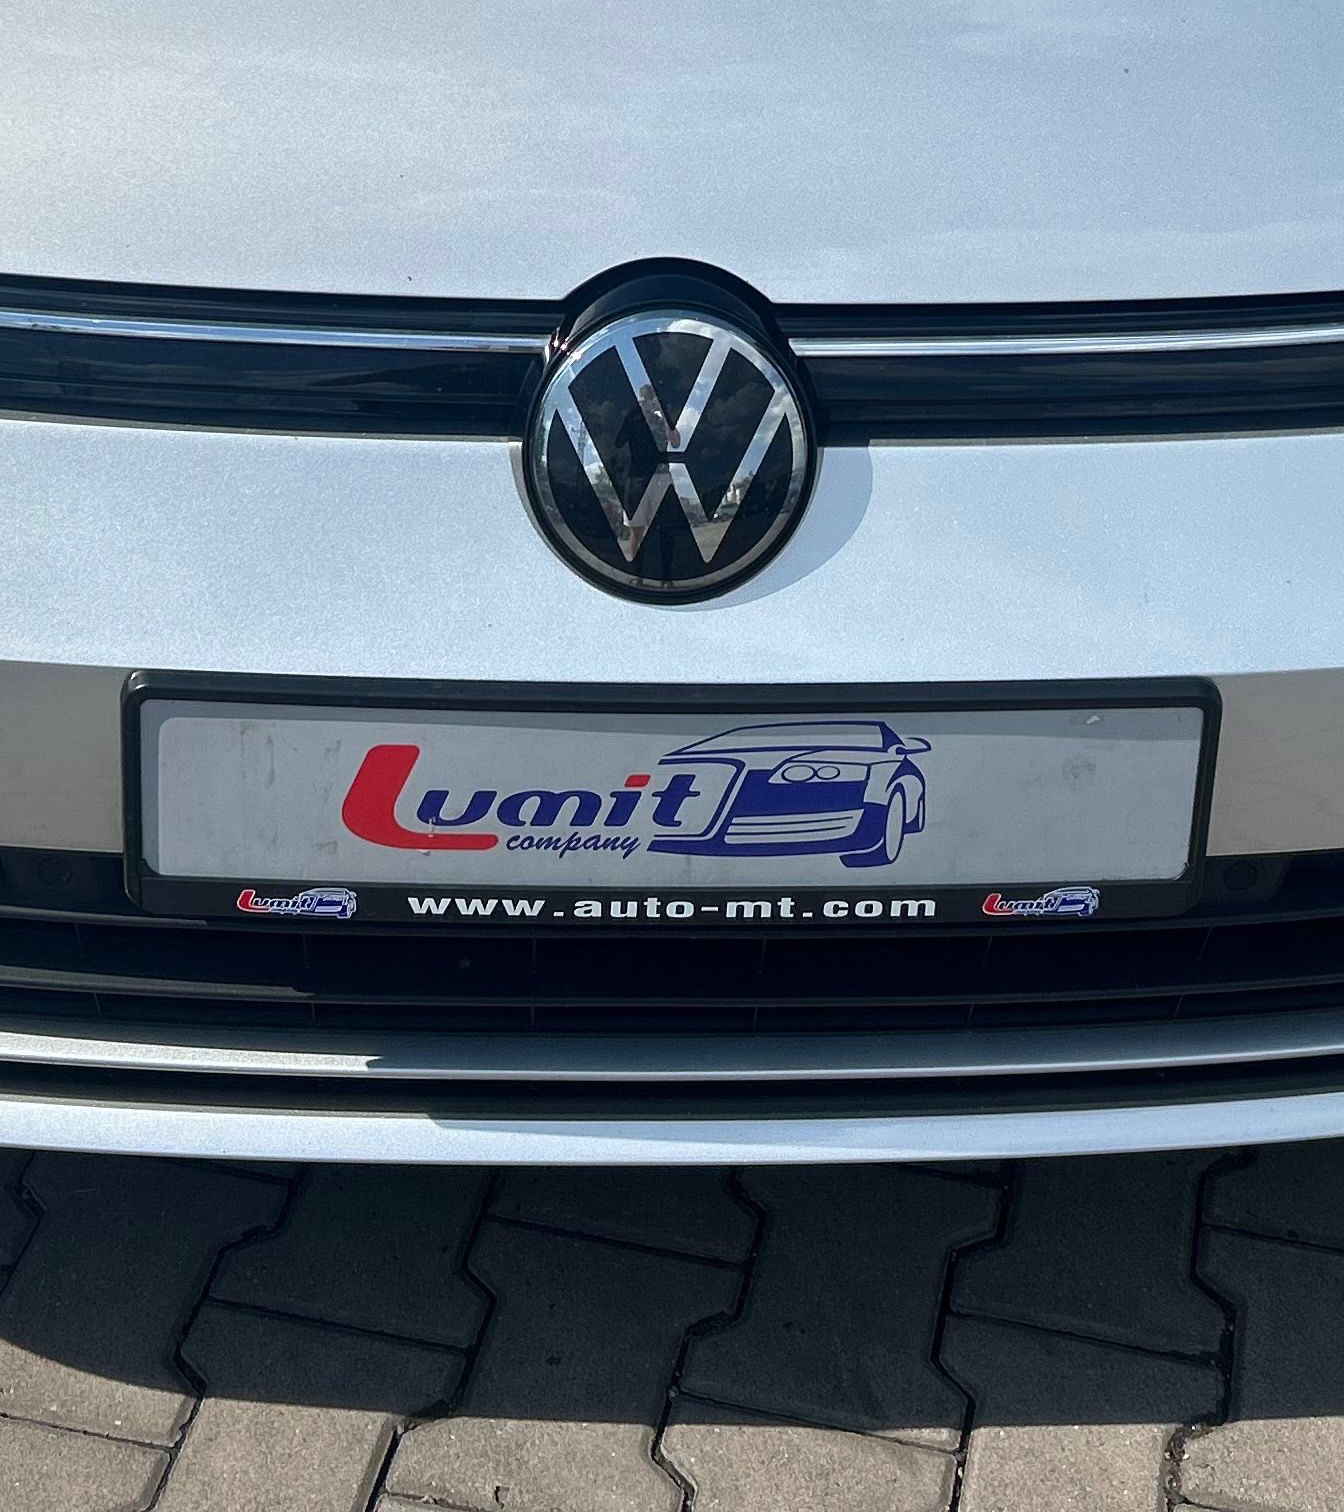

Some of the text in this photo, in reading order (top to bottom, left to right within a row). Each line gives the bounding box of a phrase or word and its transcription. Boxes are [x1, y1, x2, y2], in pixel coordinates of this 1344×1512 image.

[551, 330, 793, 565] VW
[341, 743, 701, 851] Lumit
[505, 832, 641, 860] company
[407, 896, 937, 919] www.auto-mt.com
